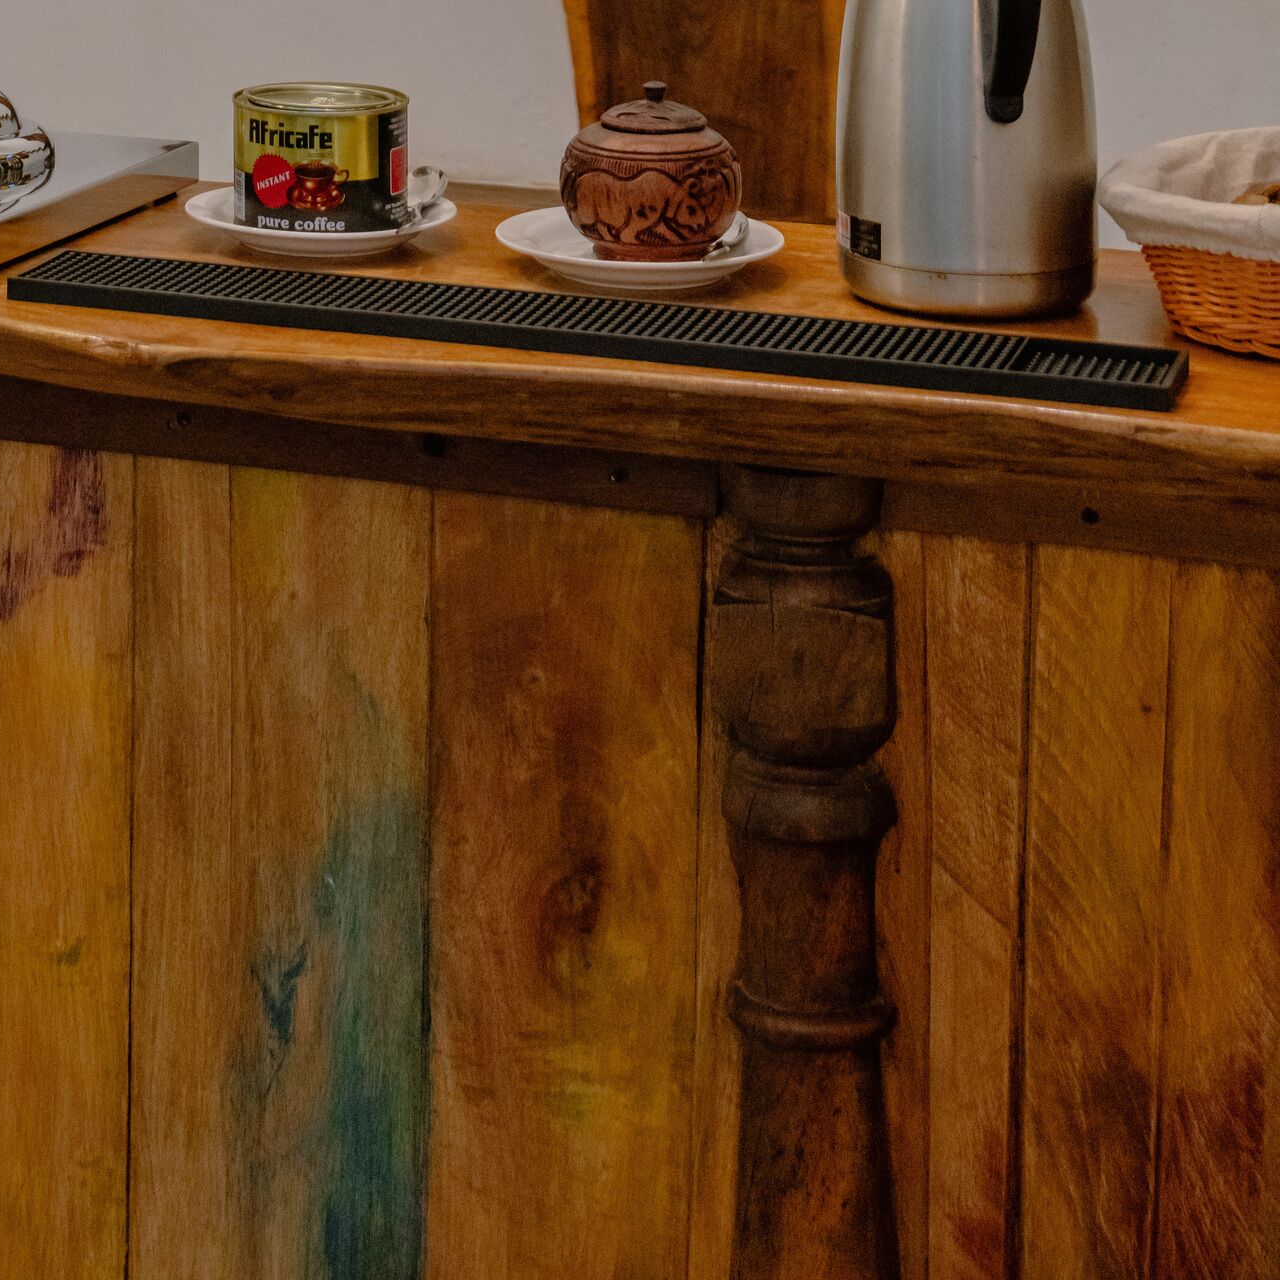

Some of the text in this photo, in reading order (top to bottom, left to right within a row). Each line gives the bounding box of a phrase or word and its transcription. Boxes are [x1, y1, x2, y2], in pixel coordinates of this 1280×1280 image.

[256, 170, 291, 191] INSTANT
[257, 215, 346, 231] pure coffee
